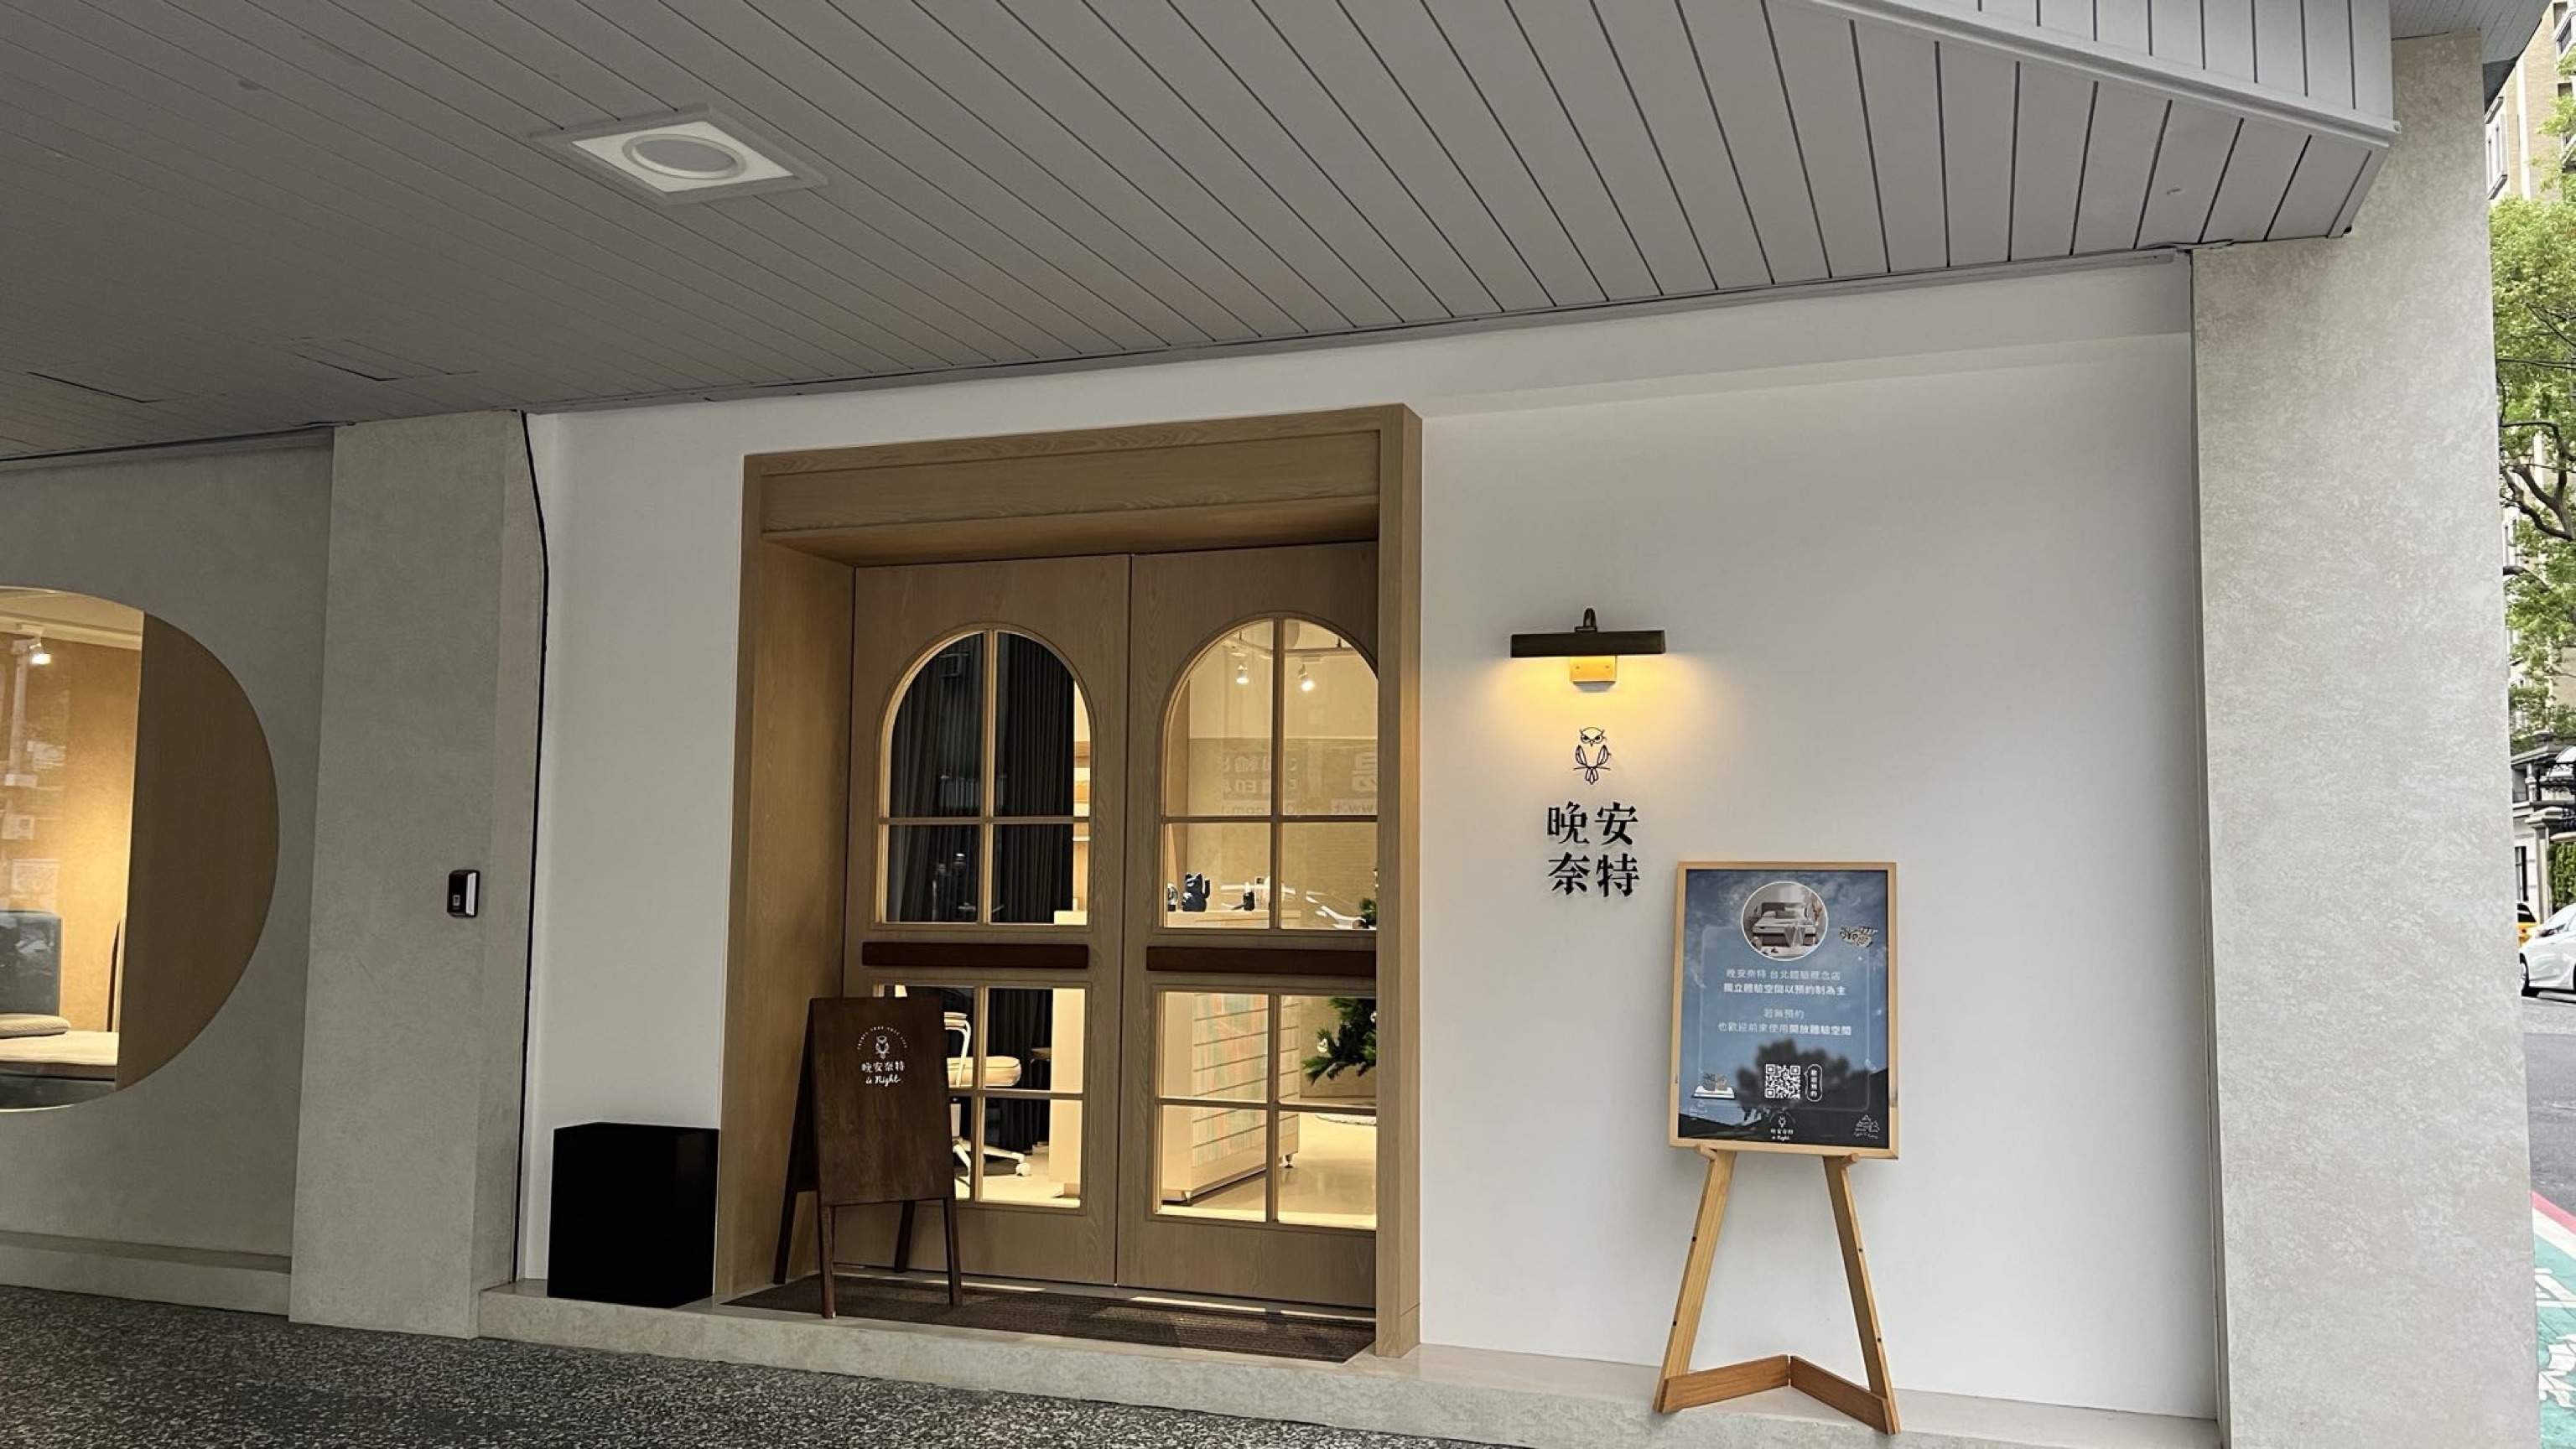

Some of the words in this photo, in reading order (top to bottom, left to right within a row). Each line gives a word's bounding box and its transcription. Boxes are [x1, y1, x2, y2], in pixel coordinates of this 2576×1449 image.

[1546, 801, 1639, 846] 晚安
[1548, 851, 1640, 898] 奈特
[861, 1061, 906, 1073] 晚安奈特
